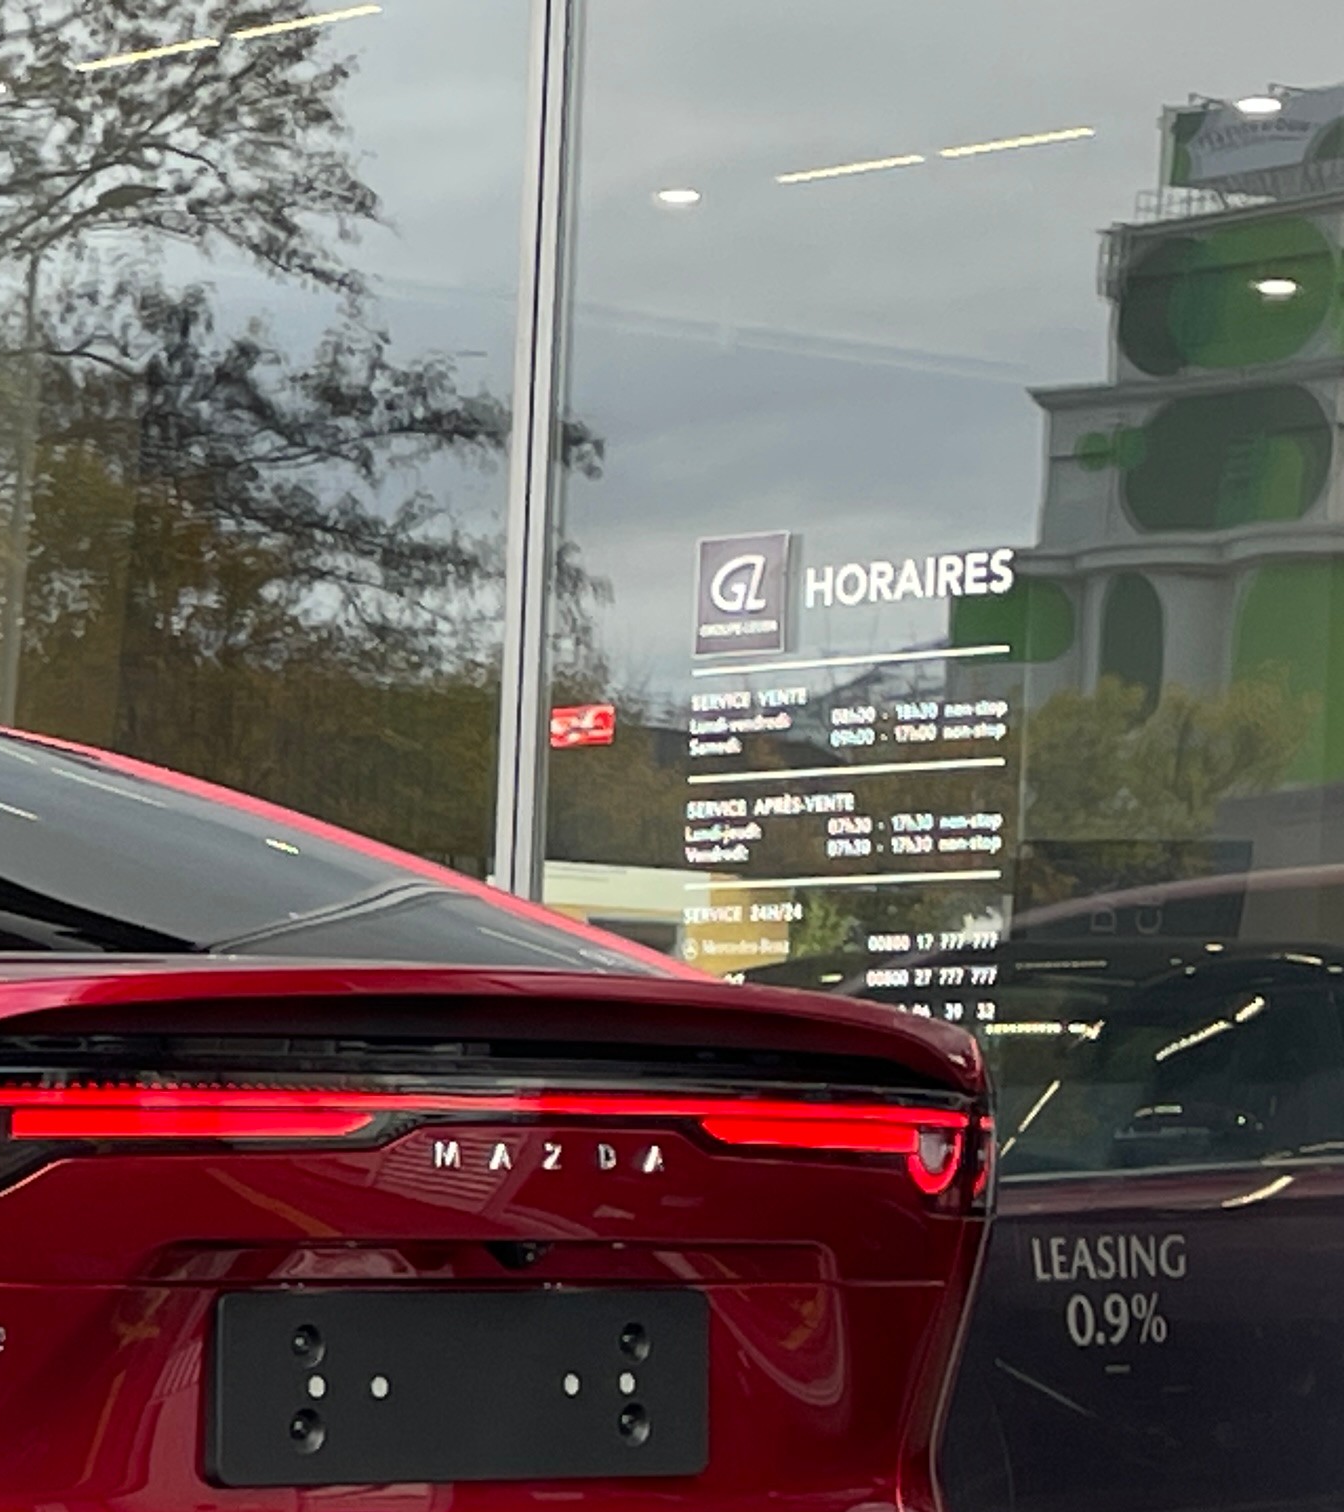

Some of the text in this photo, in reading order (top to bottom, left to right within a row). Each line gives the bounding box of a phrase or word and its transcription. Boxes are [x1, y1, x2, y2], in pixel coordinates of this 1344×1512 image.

[806, 548, 1016, 609] HORAIRES
[691, 687, 808, 711] SERVICE VENTE
[943, 700, 1009, 719] non-stop
[942, 722, 1007, 741] non-stop
[686, 792, 855, 820] SERVICE APRÈS-VENTE
[939, 813, 1004, 831] non-stop
[938, 835, 1002, 854] non-stop
[683, 905, 743, 924] SERVICE
[916, 933, 934, 950] 17
[939, 932, 964, 950] 777
[972, 931, 999, 950] 777
[914, 968, 933, 987] 27
[939, 967, 964, 986] 777
[971, 966, 998, 986] 777
[434, 1140, 666, 1174] MAZDA
[1031, 1233, 1187, 1282] LEASING
[1066, 1291, 1168, 1347] 0.9%
